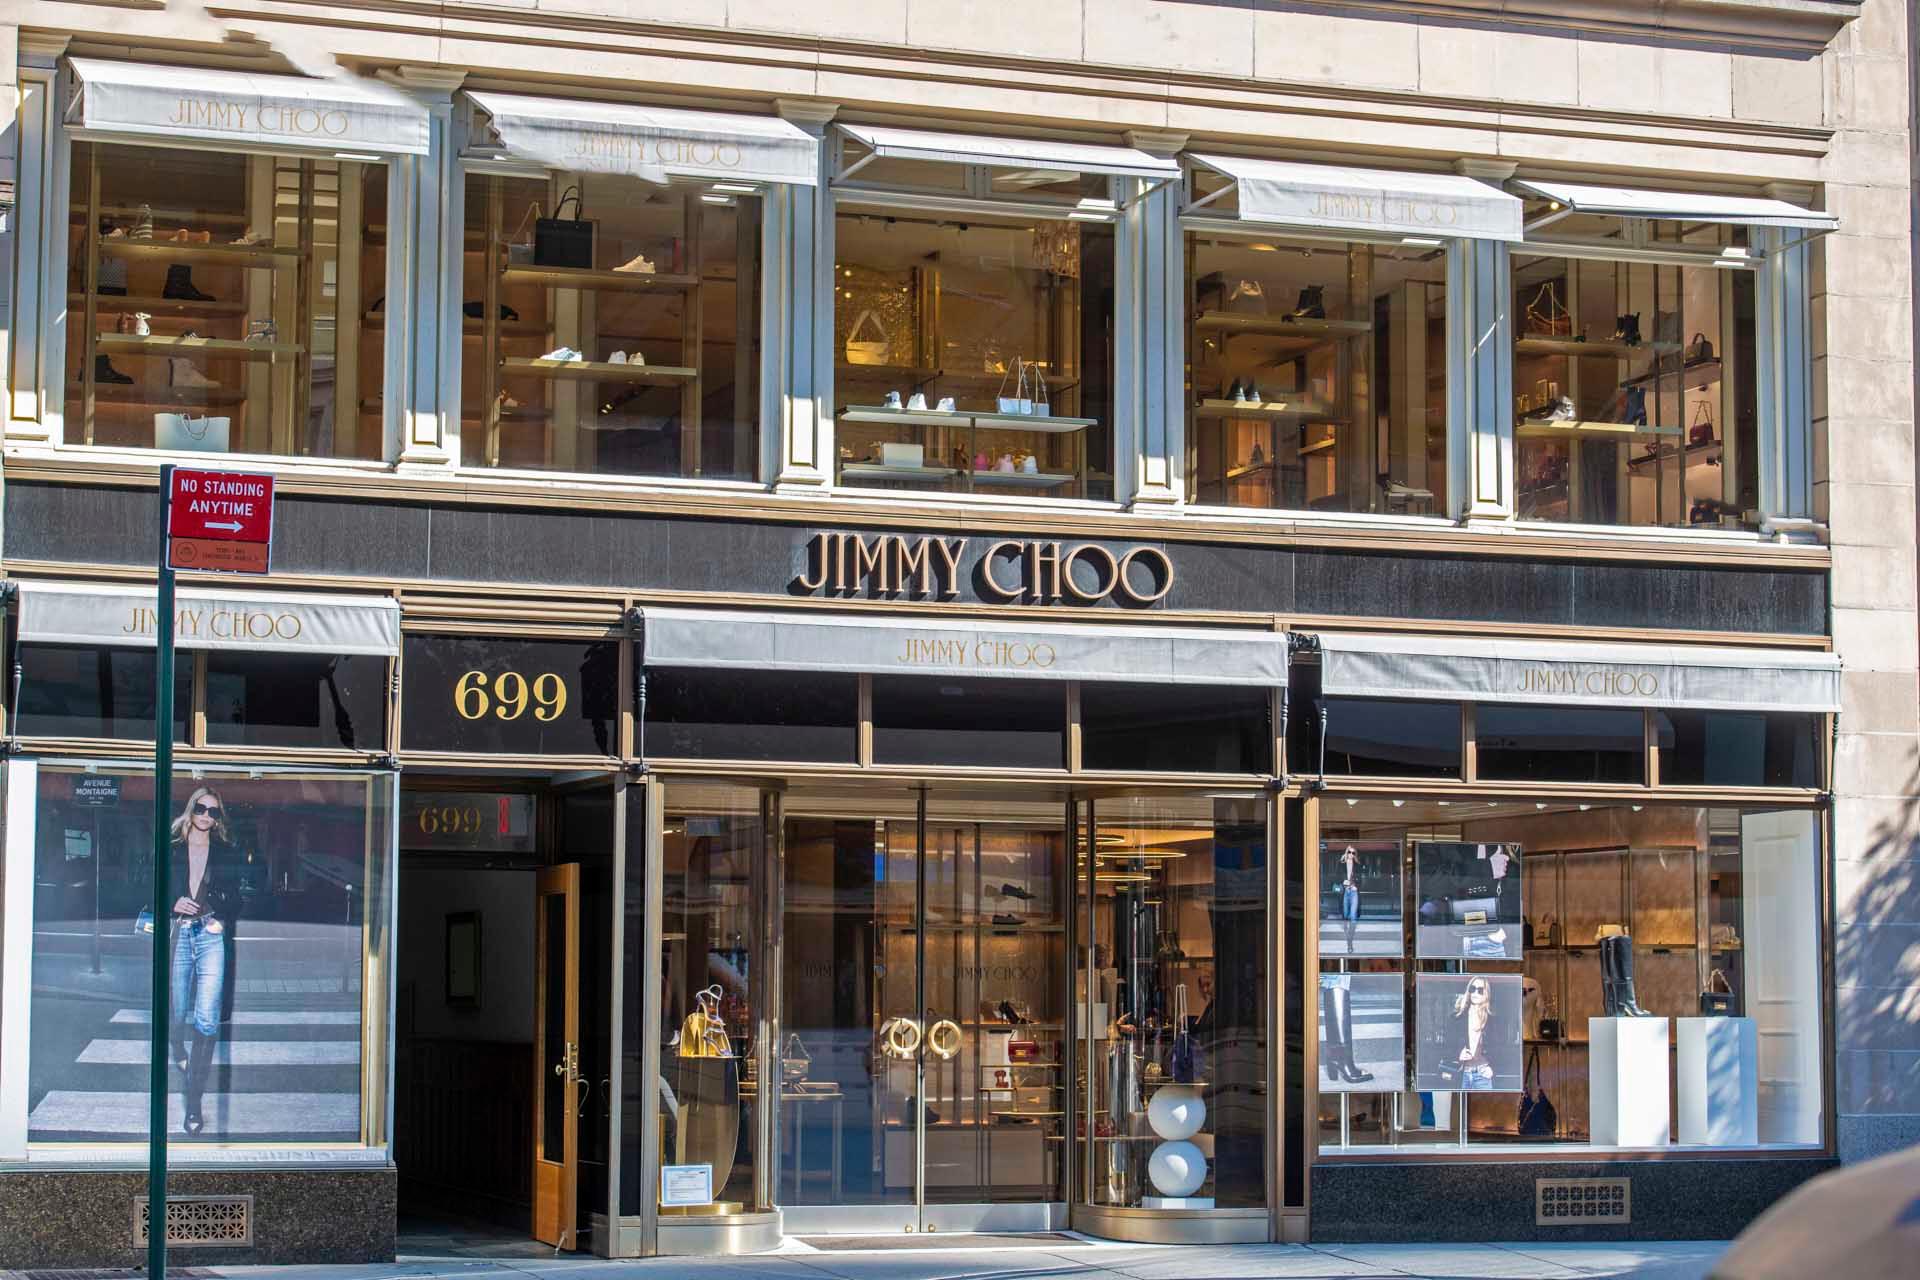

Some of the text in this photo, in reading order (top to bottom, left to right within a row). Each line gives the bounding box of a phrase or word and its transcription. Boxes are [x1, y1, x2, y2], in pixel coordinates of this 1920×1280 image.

[169, 99, 349, 135] JIMMY CHOO
[575, 133, 742, 166] JIMMY CHOO
[1310, 191, 1457, 224] JIMMY CHOO
[181, 479, 264, 497] NO STANDING
[189, 500, 253, 516] ANYTIME
[799, 532, 1175, 601] JIMMY CHOO
[210, 611, 301, 639] CHOO
[898, 639, 1056, 667] JIMMY CHOO
[455, 671, 567, 722] 699
[1517, 669, 1658, 696] JIMMY CHOO
[75, 788, 118, 796] MONTAIGNE
[83, 779, 112, 787] AVENUE
[420, 807, 481, 833] 699
